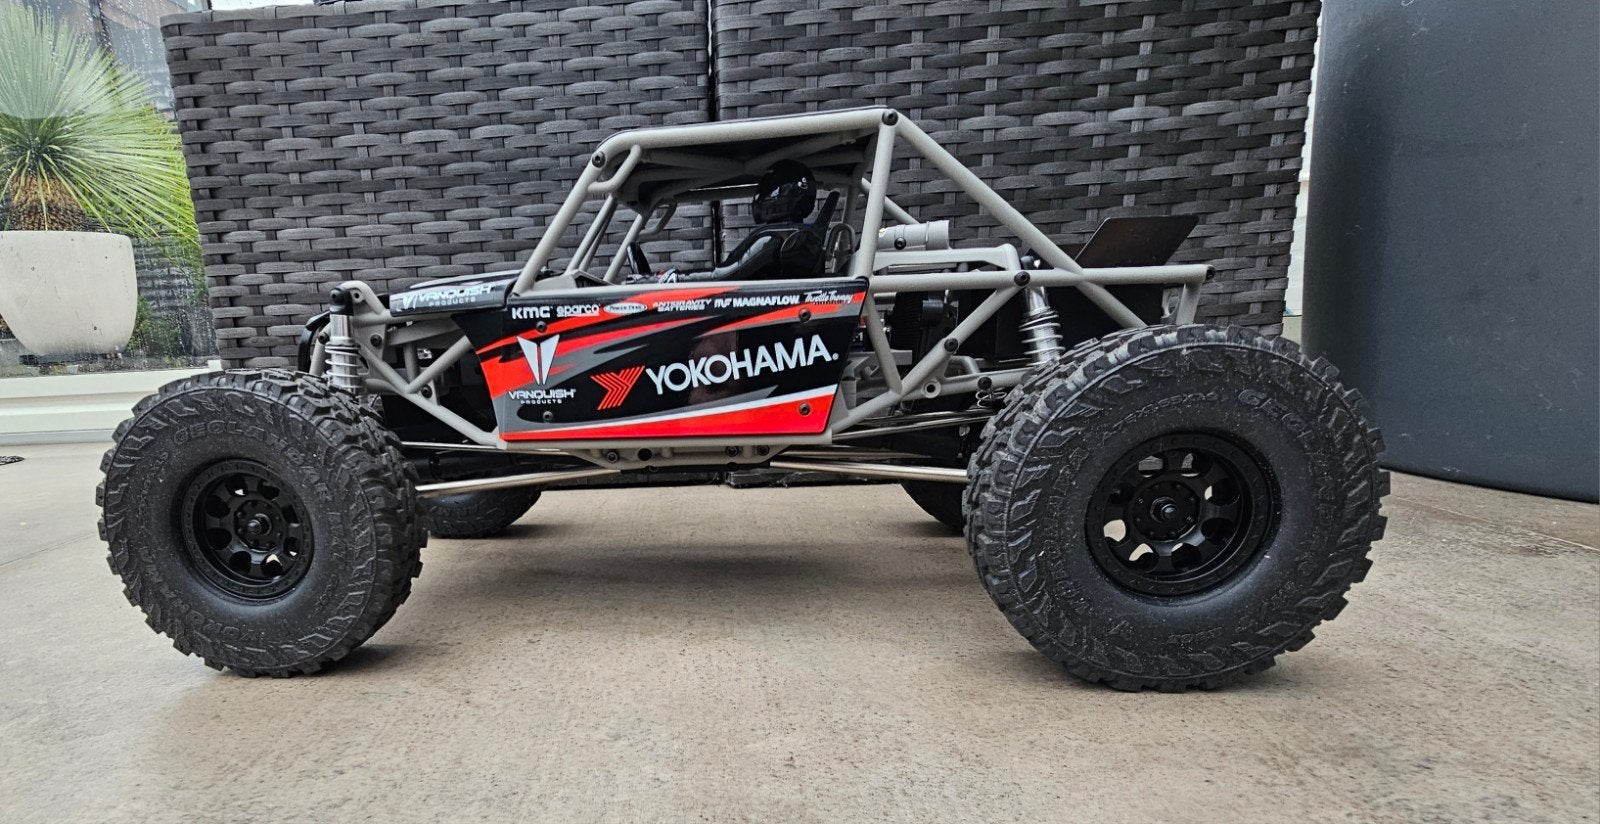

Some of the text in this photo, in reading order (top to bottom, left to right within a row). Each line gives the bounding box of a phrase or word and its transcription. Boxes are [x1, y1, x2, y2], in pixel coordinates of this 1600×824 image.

[418, 283, 493, 302] VANQUISH
[428, 297, 476, 307] PRODUCTS
[732, 295, 800, 307] MAGNAFLOW
[556, 304, 601, 317] sparco
[508, 388, 576, 400] VANQUISH
